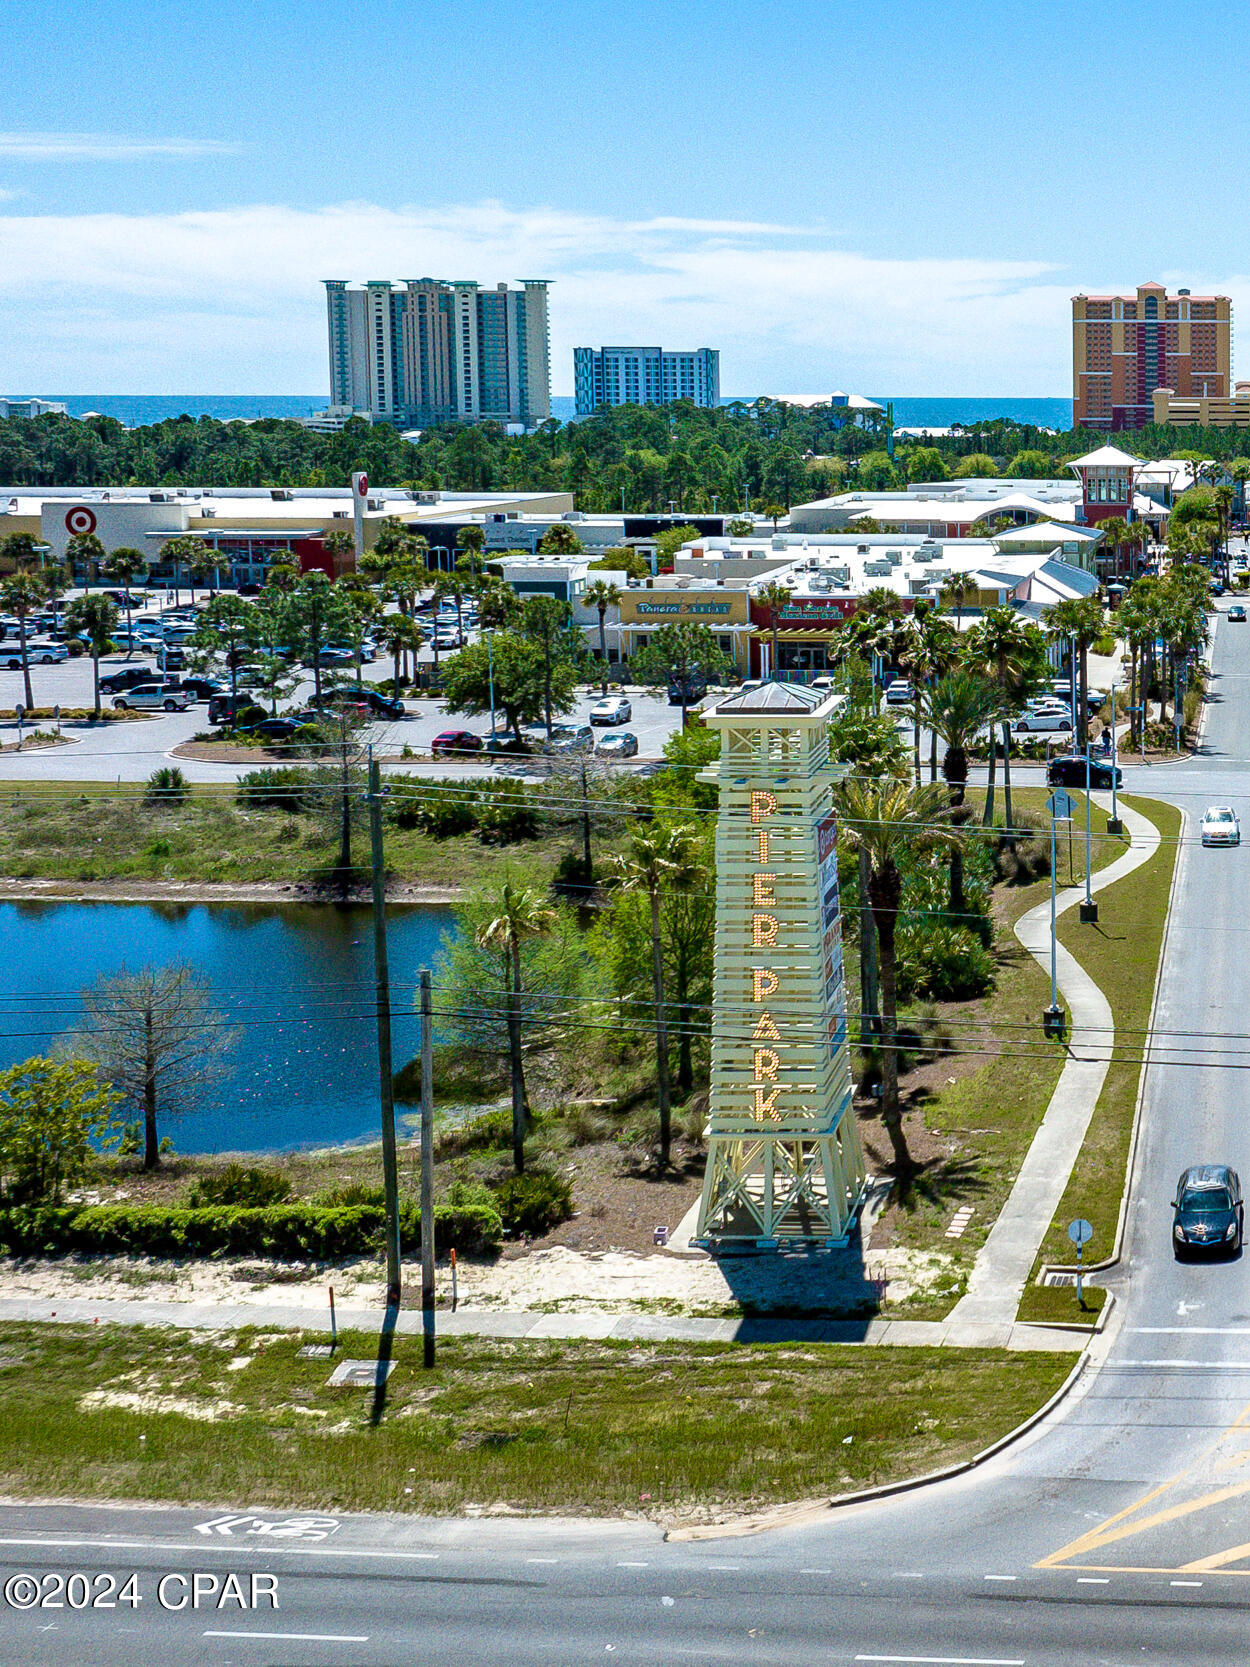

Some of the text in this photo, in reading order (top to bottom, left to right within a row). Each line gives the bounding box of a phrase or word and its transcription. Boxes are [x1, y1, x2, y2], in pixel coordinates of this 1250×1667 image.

[638, 602, 679, 614] Panera
[751, 791, 783, 1122] PIER PARK
